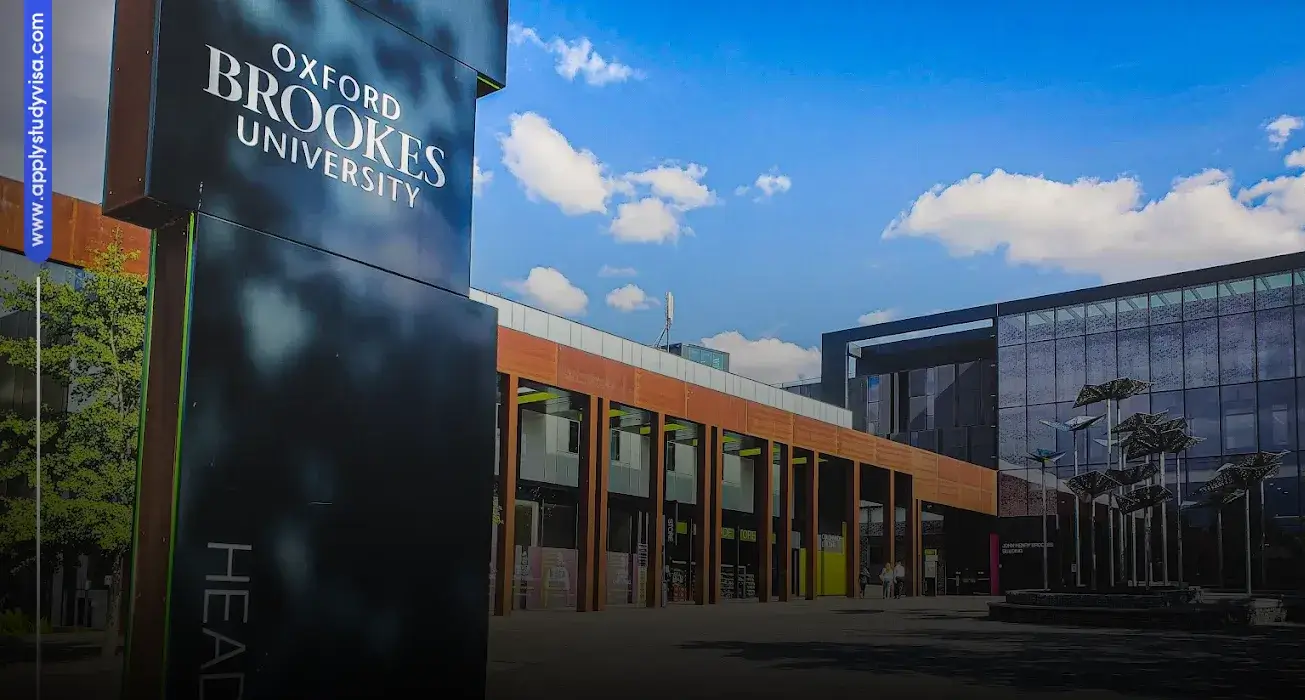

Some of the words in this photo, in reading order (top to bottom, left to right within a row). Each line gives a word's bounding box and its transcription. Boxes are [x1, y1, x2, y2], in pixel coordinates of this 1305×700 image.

[203, 43, 446, 188] BROOKES
[271, 43, 401, 121] OXFORD
[237, 115, 420, 208] UNIVERSITY
